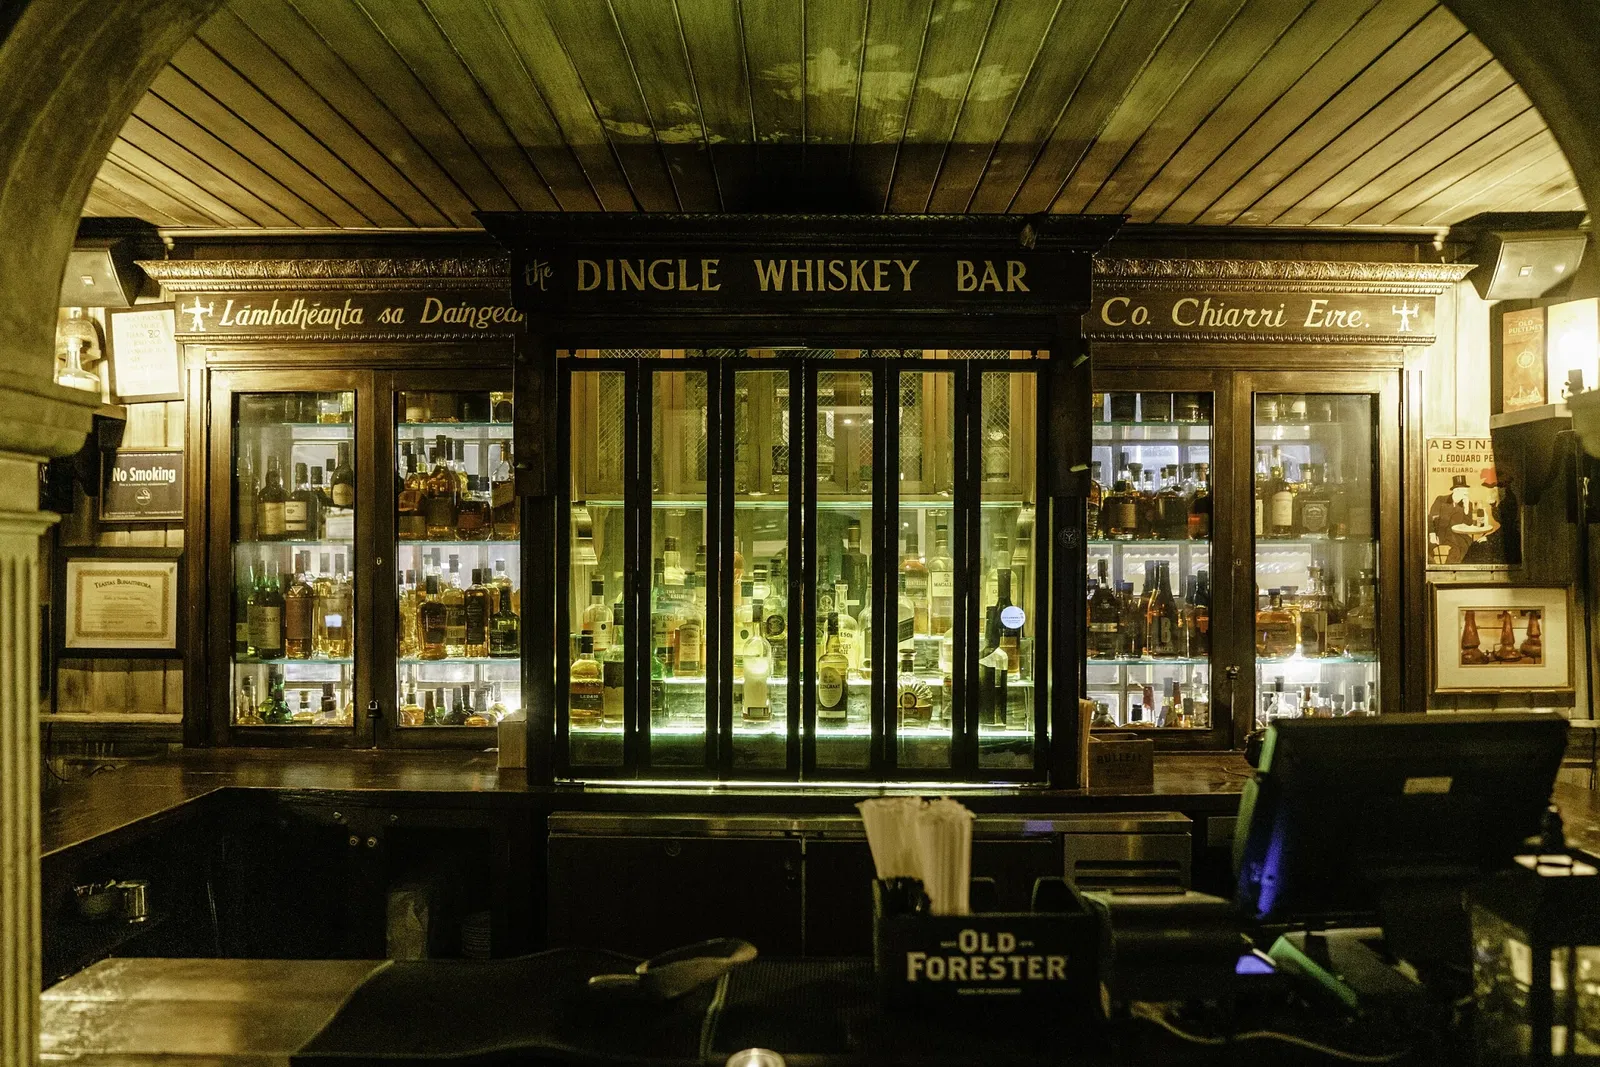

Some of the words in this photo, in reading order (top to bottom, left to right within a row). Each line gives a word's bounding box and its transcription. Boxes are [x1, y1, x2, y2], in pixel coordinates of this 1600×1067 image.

[522, 259, 553, 292] the
[577, 259, 721, 291] DINGLE
[753, 259, 920, 291] WHISKEY
[956, 259, 1030, 292] BAR
[218, 298, 364, 330] Lámhdhéanta
[377, 307, 405, 324] sa
[420, 297, 524, 329] Daingea
[1101, 297, 1151, 326] Co.
[1171, 297, 1288, 327] Chiarri
[112, 467, 127, 481] No
[130, 466, 176, 483] Smoking
[958, 928, 1017, 954] OLD
[906, 951, 1069, 982] FORESTER
